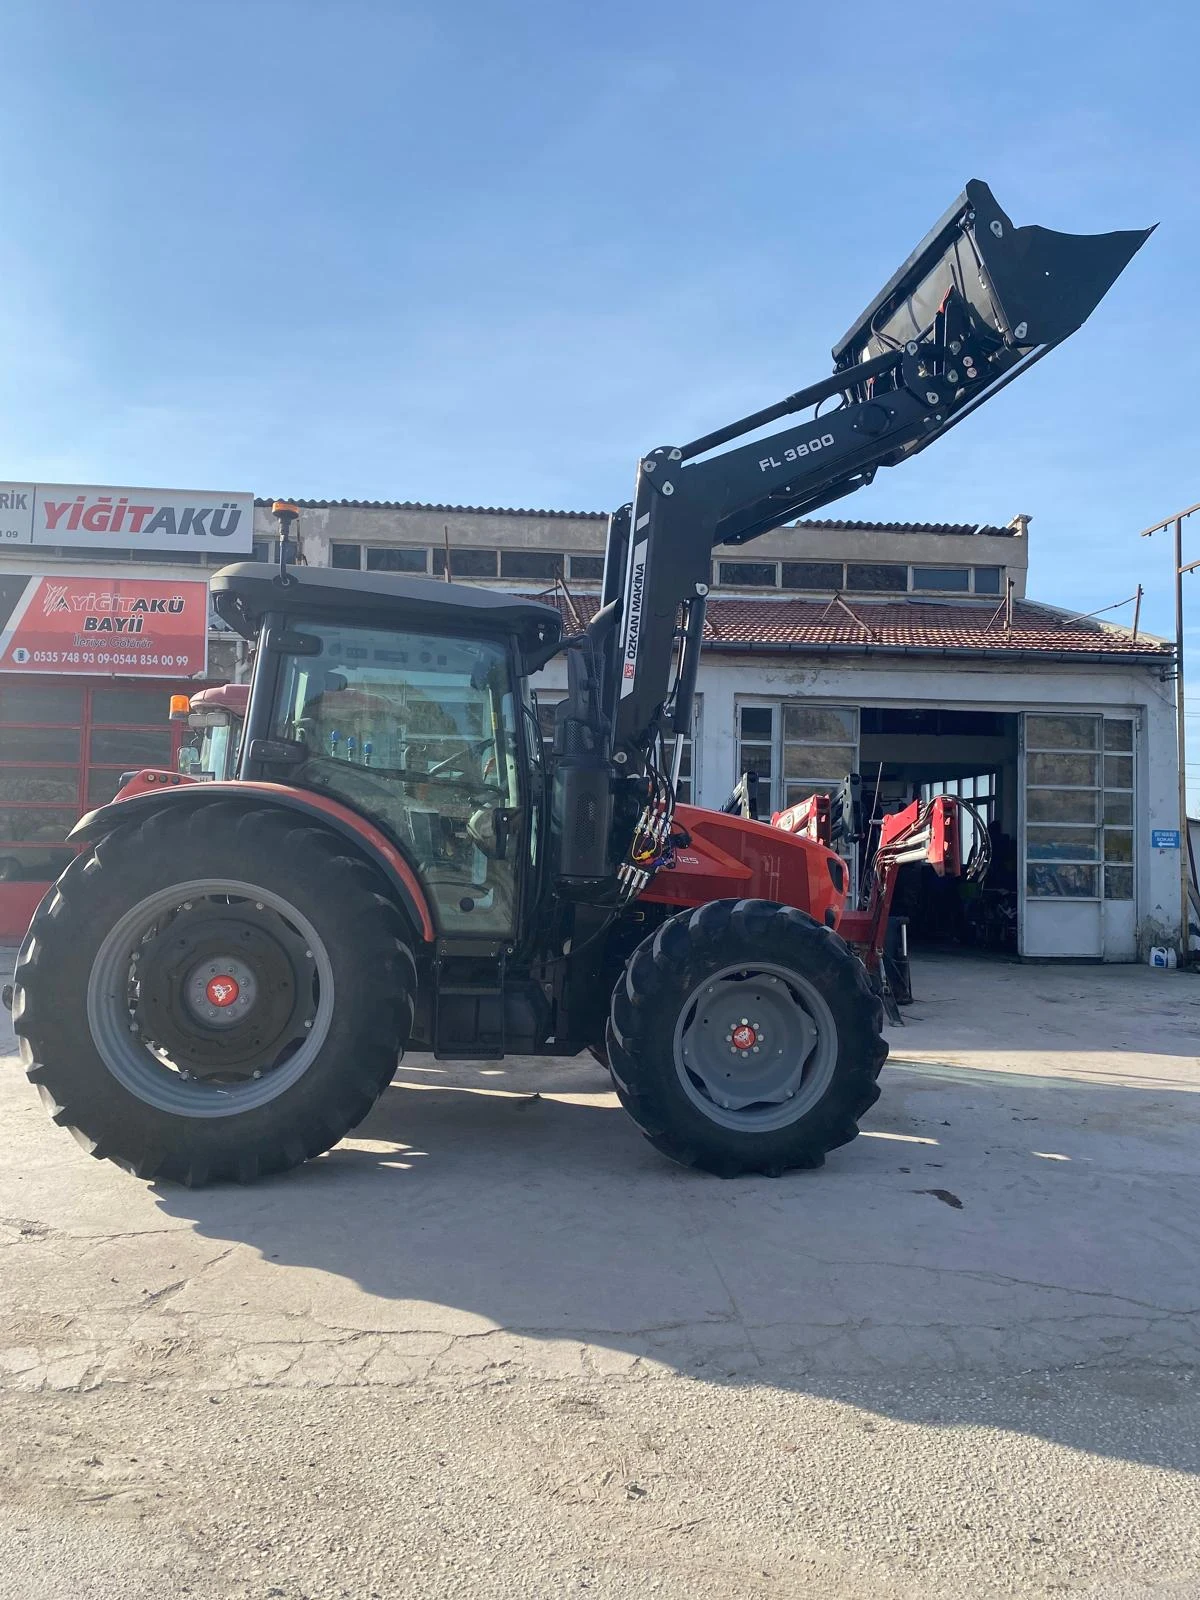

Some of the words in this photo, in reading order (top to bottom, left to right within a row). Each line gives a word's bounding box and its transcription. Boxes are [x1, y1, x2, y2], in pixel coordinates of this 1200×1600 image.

[758, 456, 782, 472] FL
[783, 433, 835, 462] 3800
[43, 495, 242, 537] YİĞİTAKÜ
[6, 530, 18, 538] 09
[631, 562, 645, 613] MAKİNA
[71, 592, 185, 614] YİĞİTAKÜ
[83, 614, 144, 634] BAYİİ
[626, 615, 640, 660] ÖZKAN
[33, 651, 58, 663] 0535
[61, 652, 80, 663] 748
[82, 652, 95, 664] 93
[97, 653, 137, 665] 09-0544
[140, 654, 158, 666] 854
[161, 655, 174, 666] 00
[176, 655, 189, 667] 99
[677, 855, 699, 865] 125
